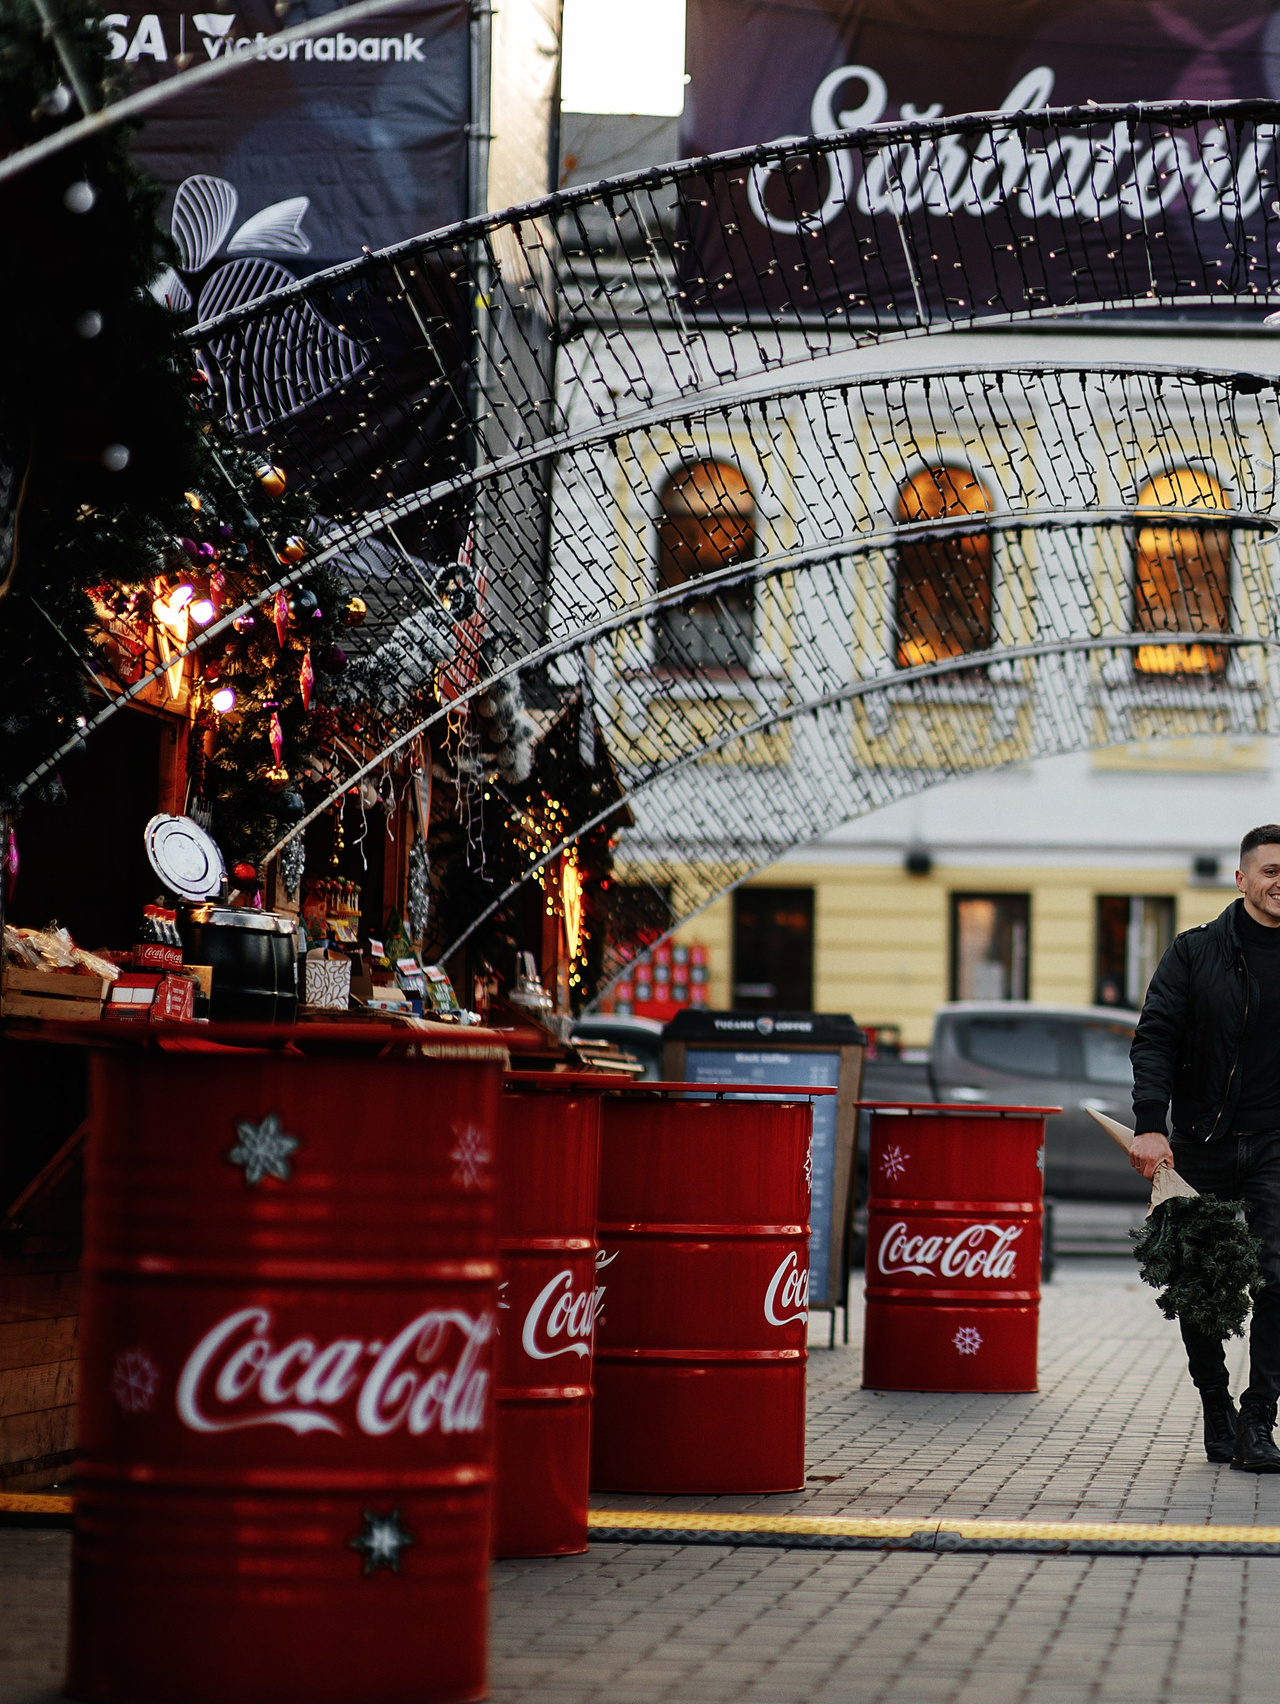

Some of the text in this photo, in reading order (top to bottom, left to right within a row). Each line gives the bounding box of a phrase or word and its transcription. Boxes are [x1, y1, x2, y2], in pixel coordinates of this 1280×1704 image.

[84, 13, 168, 62] SA
[878, 1222, 1023, 1279] Coca-Cola
[175, 1306, 493, 1438] Coca-Cola
